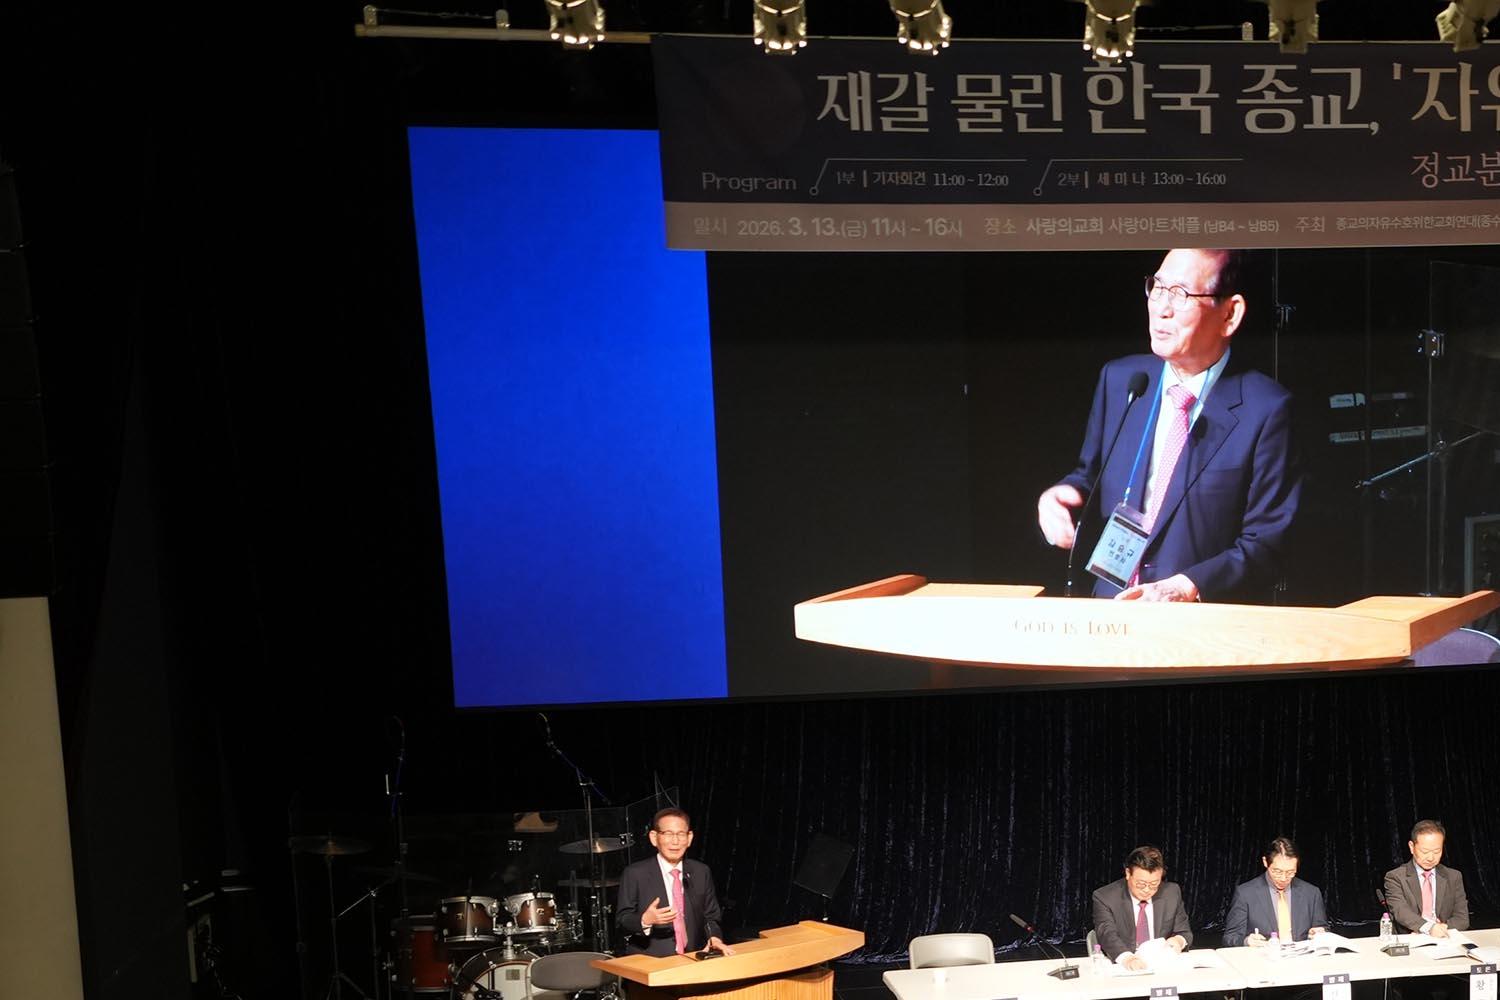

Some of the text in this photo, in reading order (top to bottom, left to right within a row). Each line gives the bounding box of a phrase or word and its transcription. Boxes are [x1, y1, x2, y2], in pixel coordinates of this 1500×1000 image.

[816, 70, 934, 134] 재갈
[951, 71, 1064, 133] 물린
[1081, 60, 1220, 135] 한국
[1235, 62, 1380, 135] 종교,
[701, 171, 797, 195] Program
[835, 170, 857, 185] 1부
[872, 169, 927, 187] 기자회견
[1057, 170, 1081, 187] 2부
[693, 216, 728, 236] 일시
[737, 219, 784, 237] 2026.
[871, 216, 907, 237] 11시
[925, 217, 964, 238] 16시
[984, 217, 1017, 236] 장소
[1026, 216, 1104, 236] 사랑의교회
[1108, 216, 1201, 235] 사랑아트채플
[1295, 215, 1325, 233] 주최
